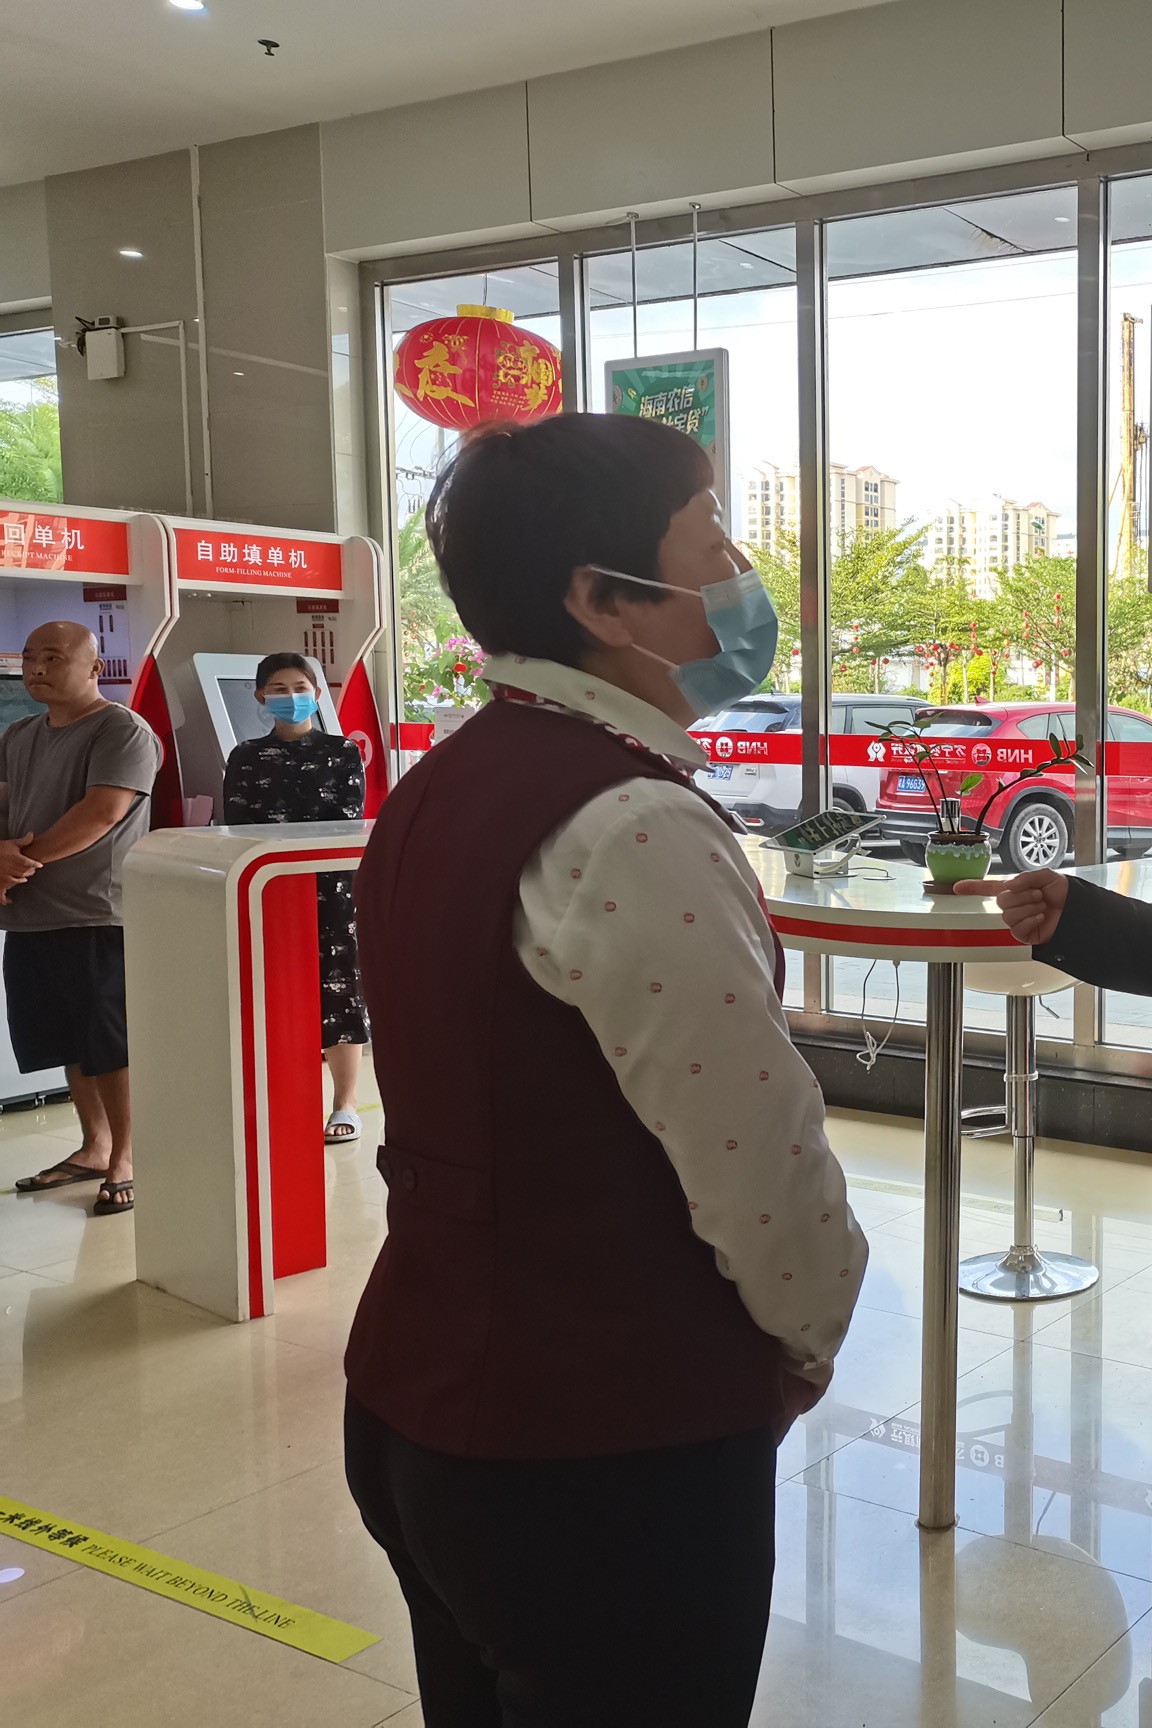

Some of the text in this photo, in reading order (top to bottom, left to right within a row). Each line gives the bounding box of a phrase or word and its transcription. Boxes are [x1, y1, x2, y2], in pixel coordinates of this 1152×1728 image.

[3, 522, 85, 550] 回单机
[197, 540, 308, 569] 自助填单机
[216, 566, 293, 579] FORM-FILLING MACHINE
[81, 1543, 137, 1567] PLEASE
[132, 1562, 173, 1580] WAIT
[165, 1575, 229, 1603] BEYOND
[255, 1609, 296, 1629] LINE
